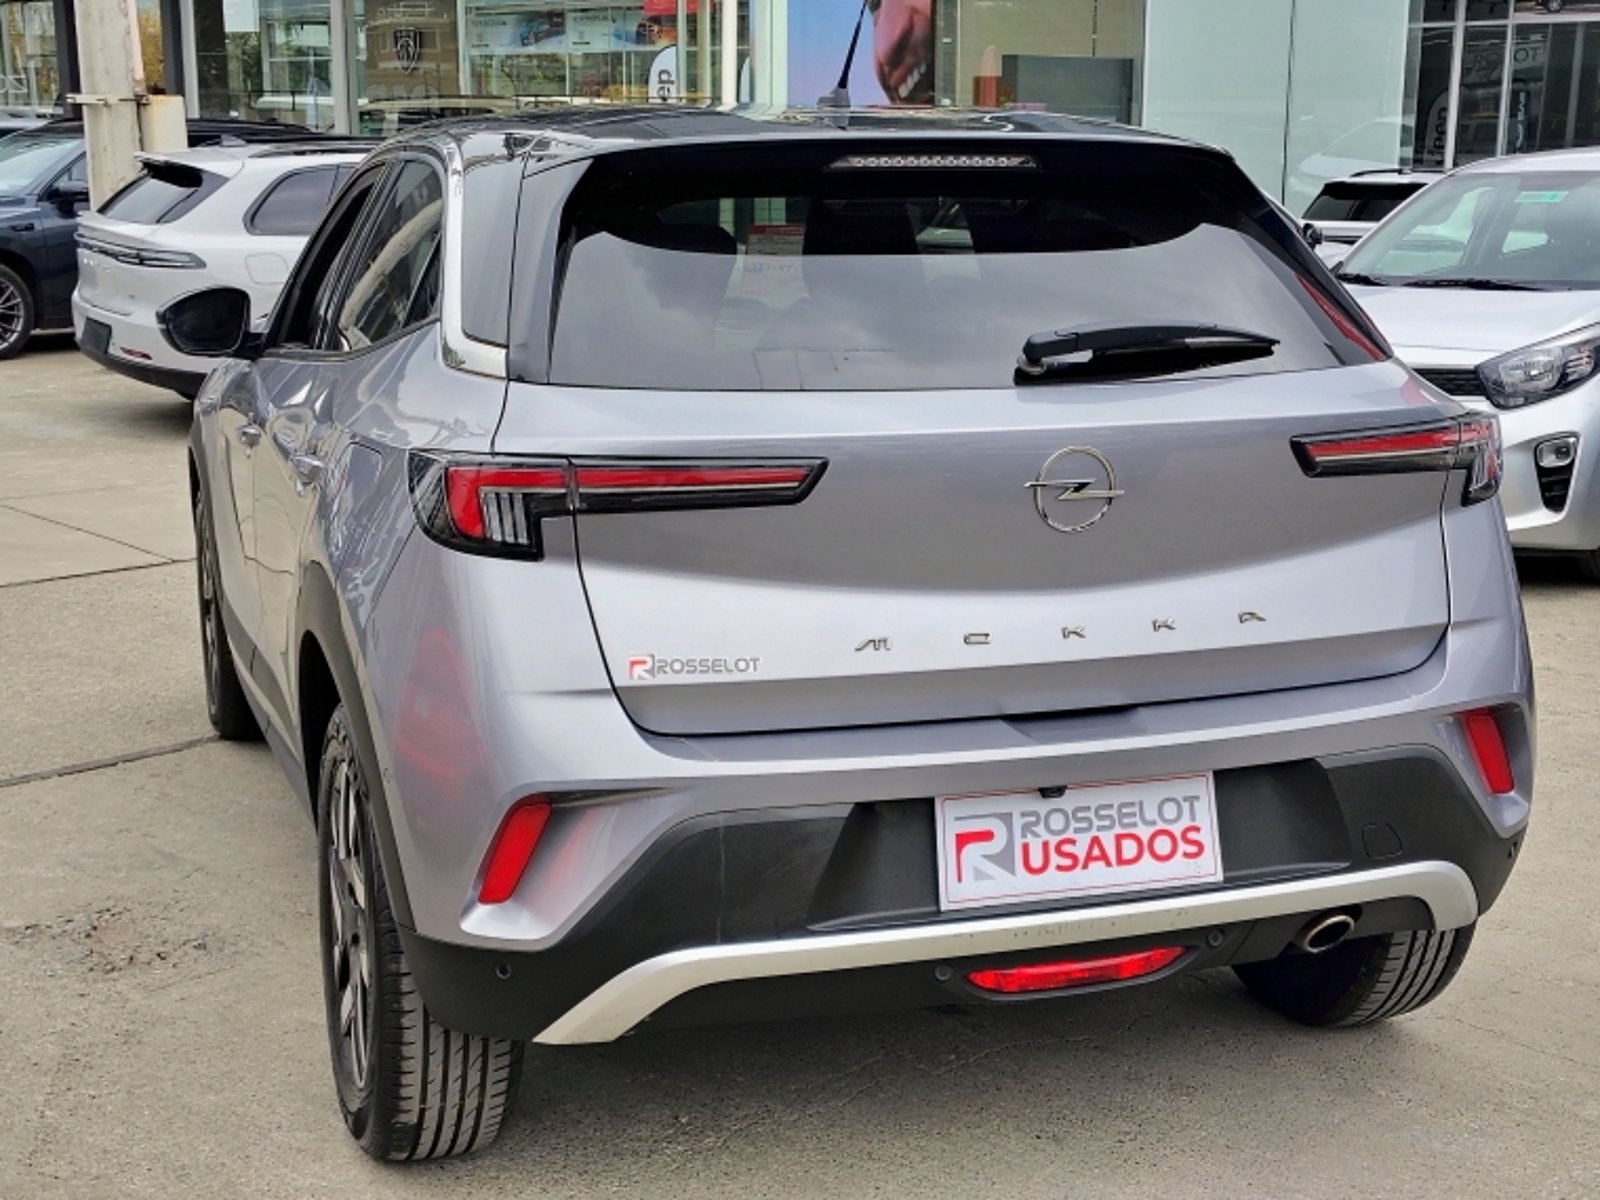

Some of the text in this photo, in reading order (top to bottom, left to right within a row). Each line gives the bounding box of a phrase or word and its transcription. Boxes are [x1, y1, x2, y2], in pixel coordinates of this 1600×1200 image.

[656, 658, 760, 675] ROSSELOT
[1020, 795, 1200, 839] ROSSELOT
[1020, 824, 1206, 876] USADOS
